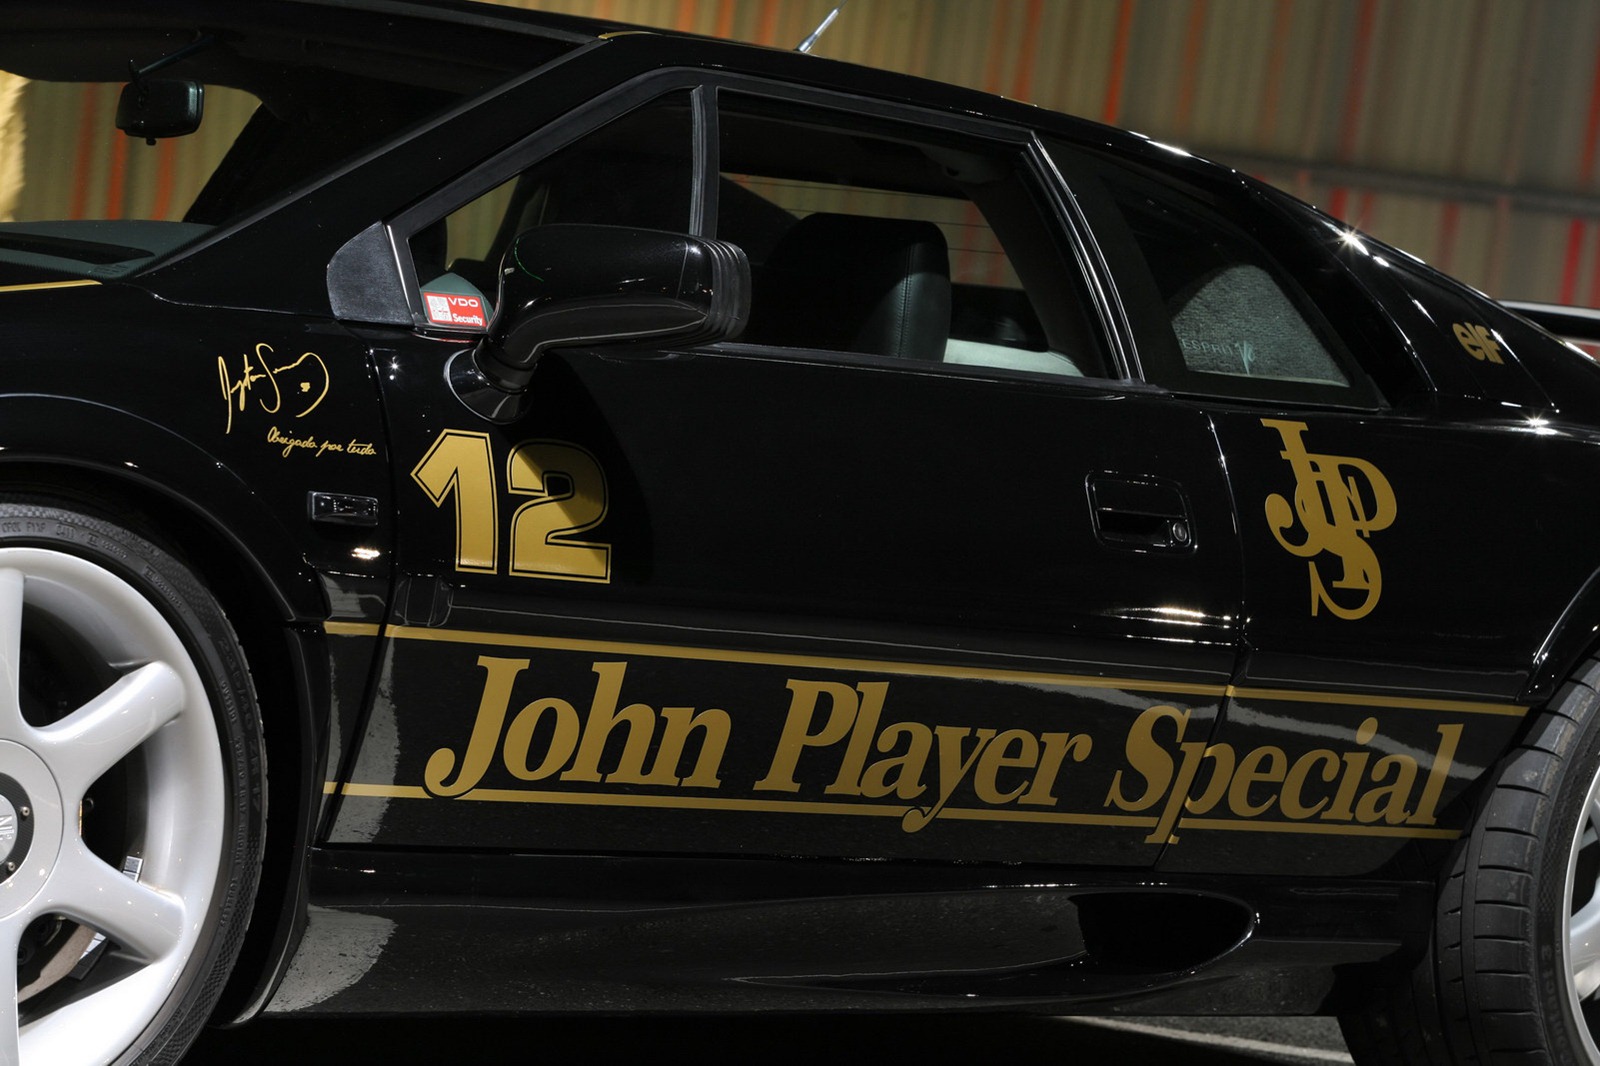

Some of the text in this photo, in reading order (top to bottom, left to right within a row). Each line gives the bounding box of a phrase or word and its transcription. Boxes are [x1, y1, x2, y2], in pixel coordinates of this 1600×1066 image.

[448, 296, 478, 307] VDO
[452, 313, 483, 326] Security
[1453, 322, 1504, 365] elf
[410, 428, 612, 584] 12
[424, 655, 1464, 844] John Player Special
